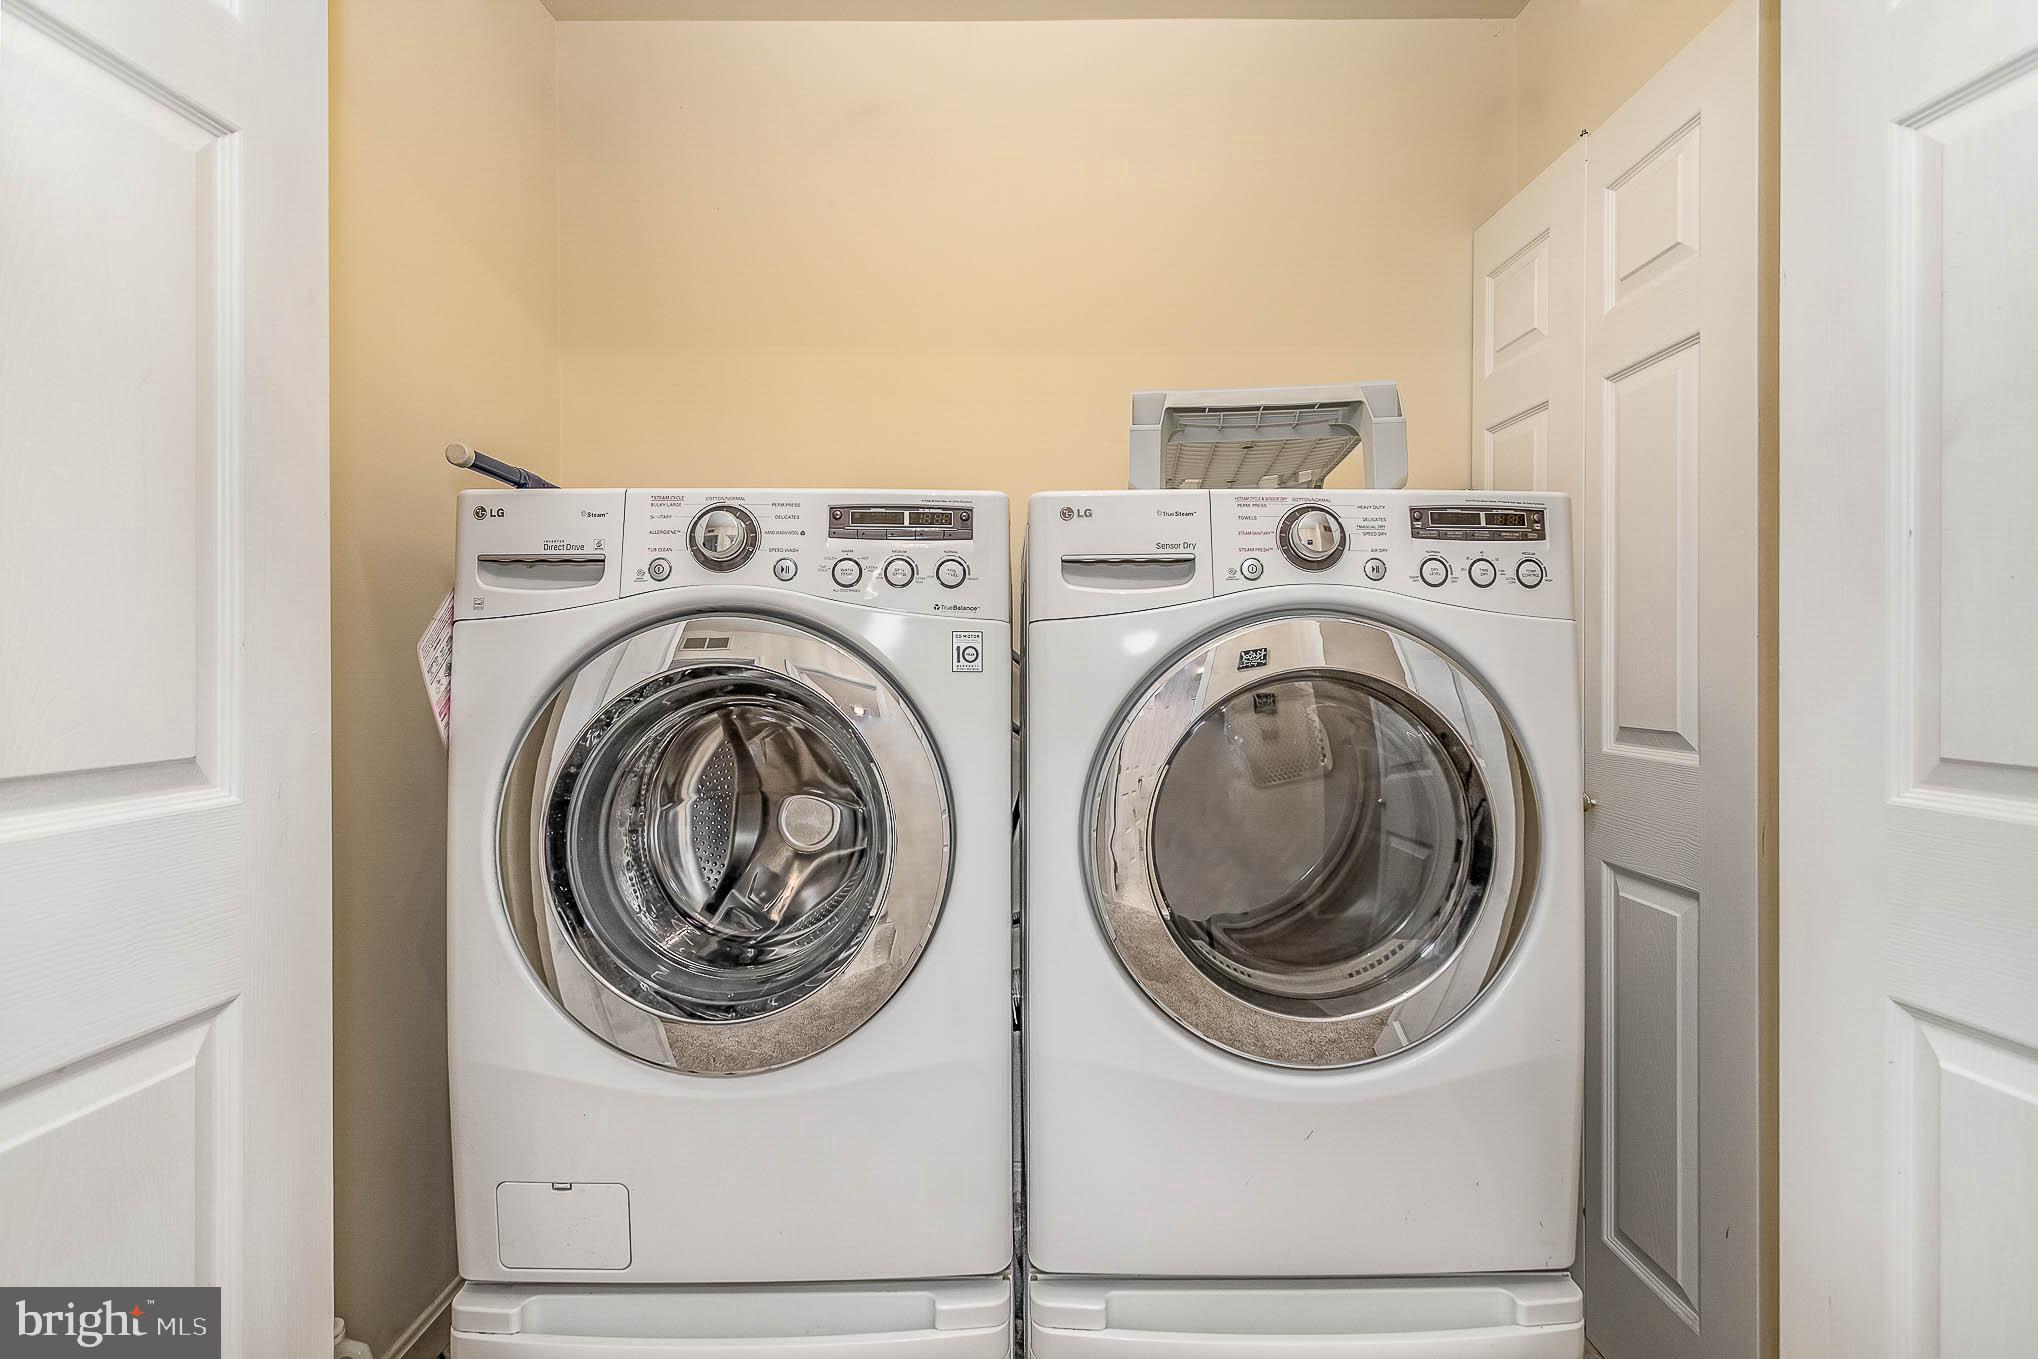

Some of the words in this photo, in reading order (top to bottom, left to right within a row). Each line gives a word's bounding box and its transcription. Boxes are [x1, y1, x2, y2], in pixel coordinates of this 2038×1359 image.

[489, 508, 505, 518] LG
[1077, 508, 1093, 518] LG
[1155, 541, 1181, 550] Sensor
[1182, 541, 1197, 551] Dry
[956, 645, 980, 664] 10
